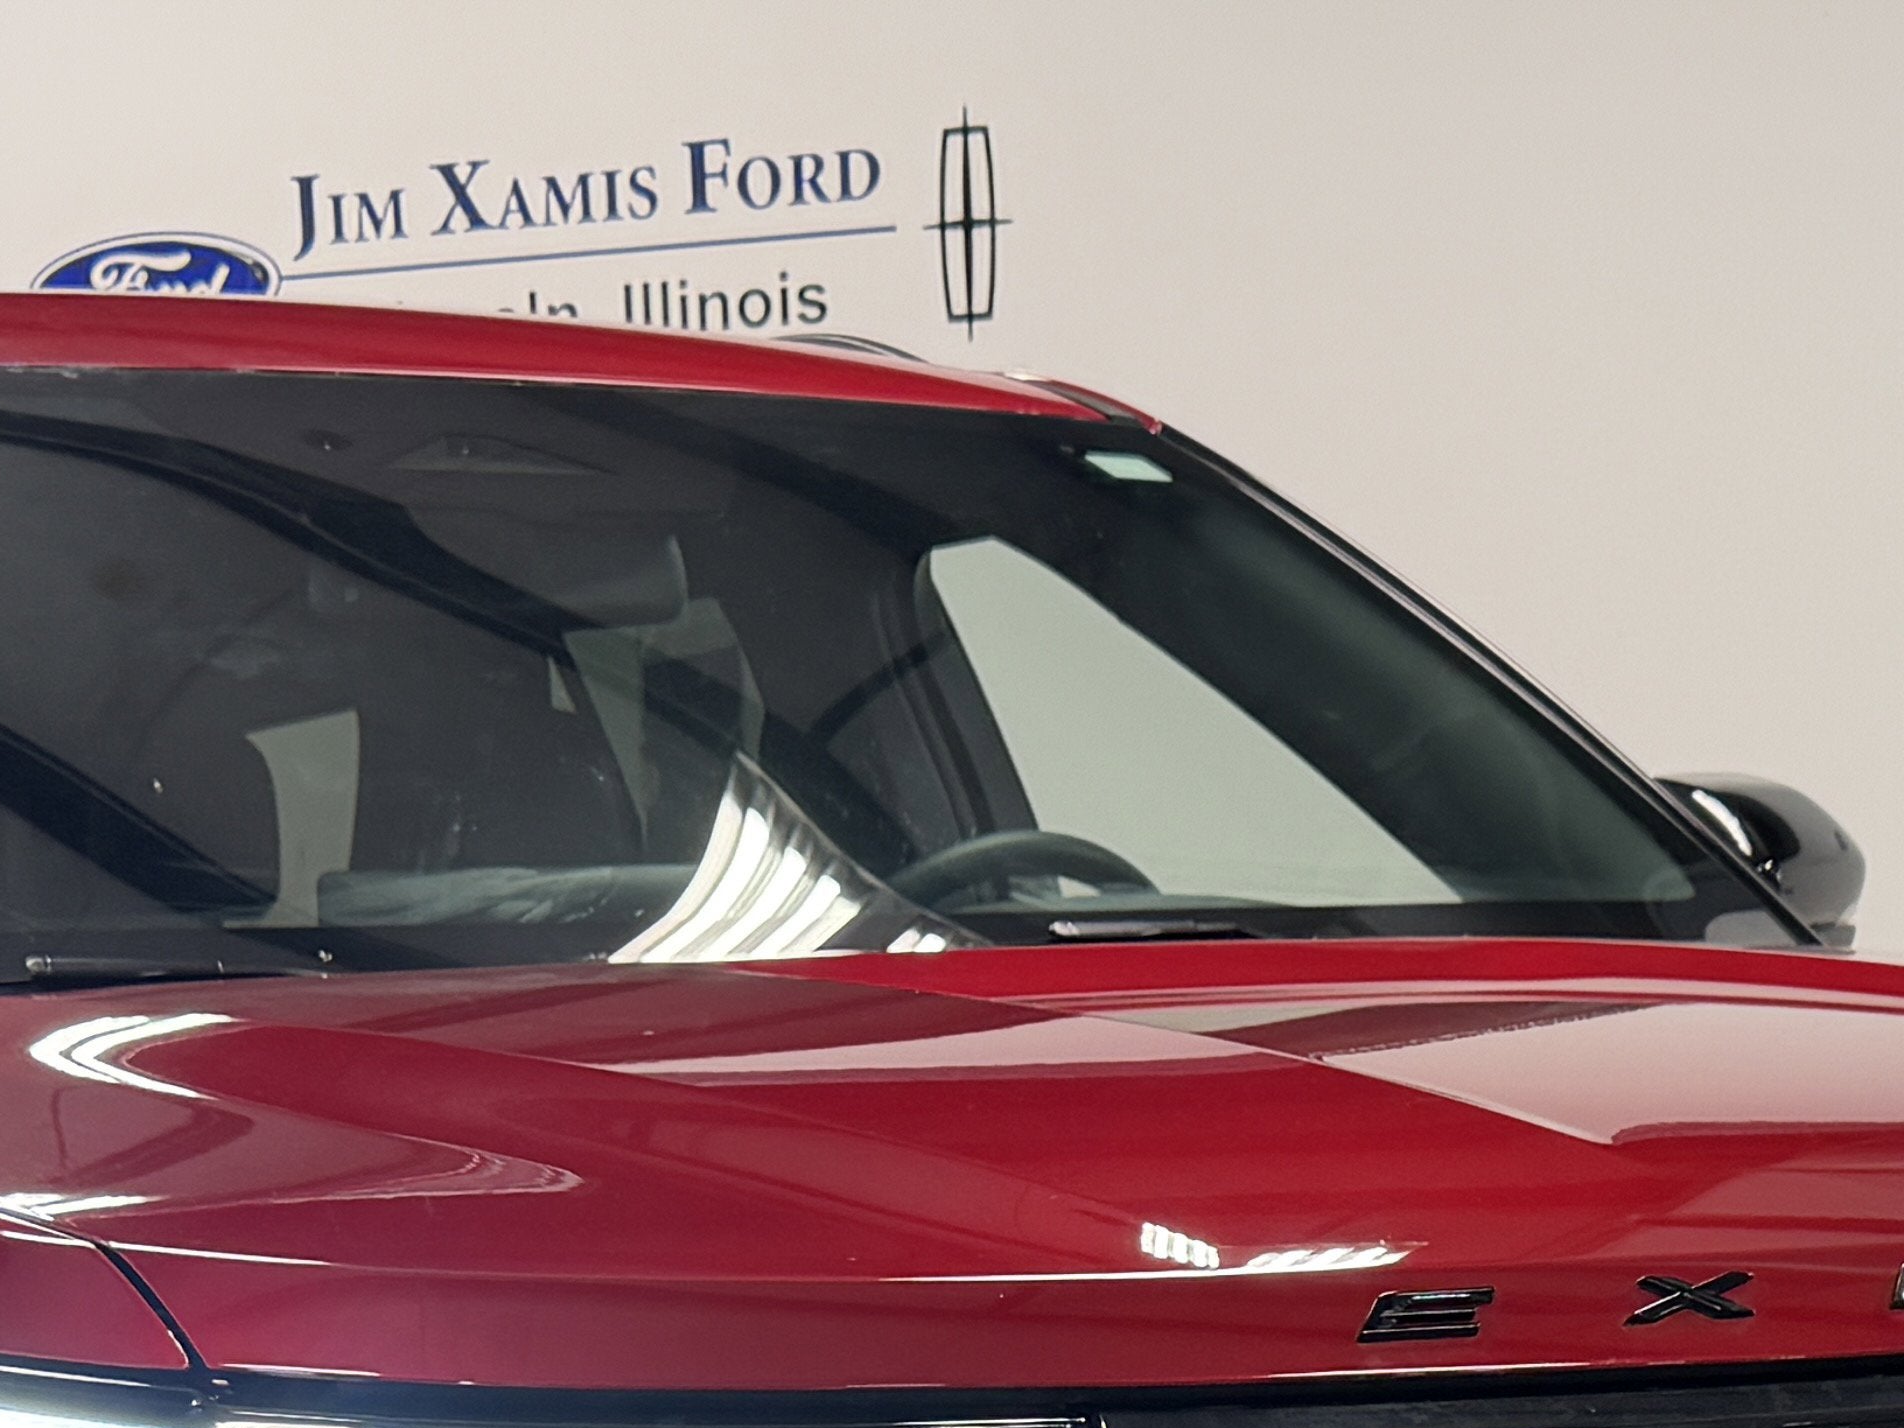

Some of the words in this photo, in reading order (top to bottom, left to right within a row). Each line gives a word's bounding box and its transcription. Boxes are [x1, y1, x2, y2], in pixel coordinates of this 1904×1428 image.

[291, 173, 409, 261] JIM
[429, 159, 659, 236] XAMIS
[681, 137, 882, 215] FORD
[623, 271, 829, 331] Illinois
